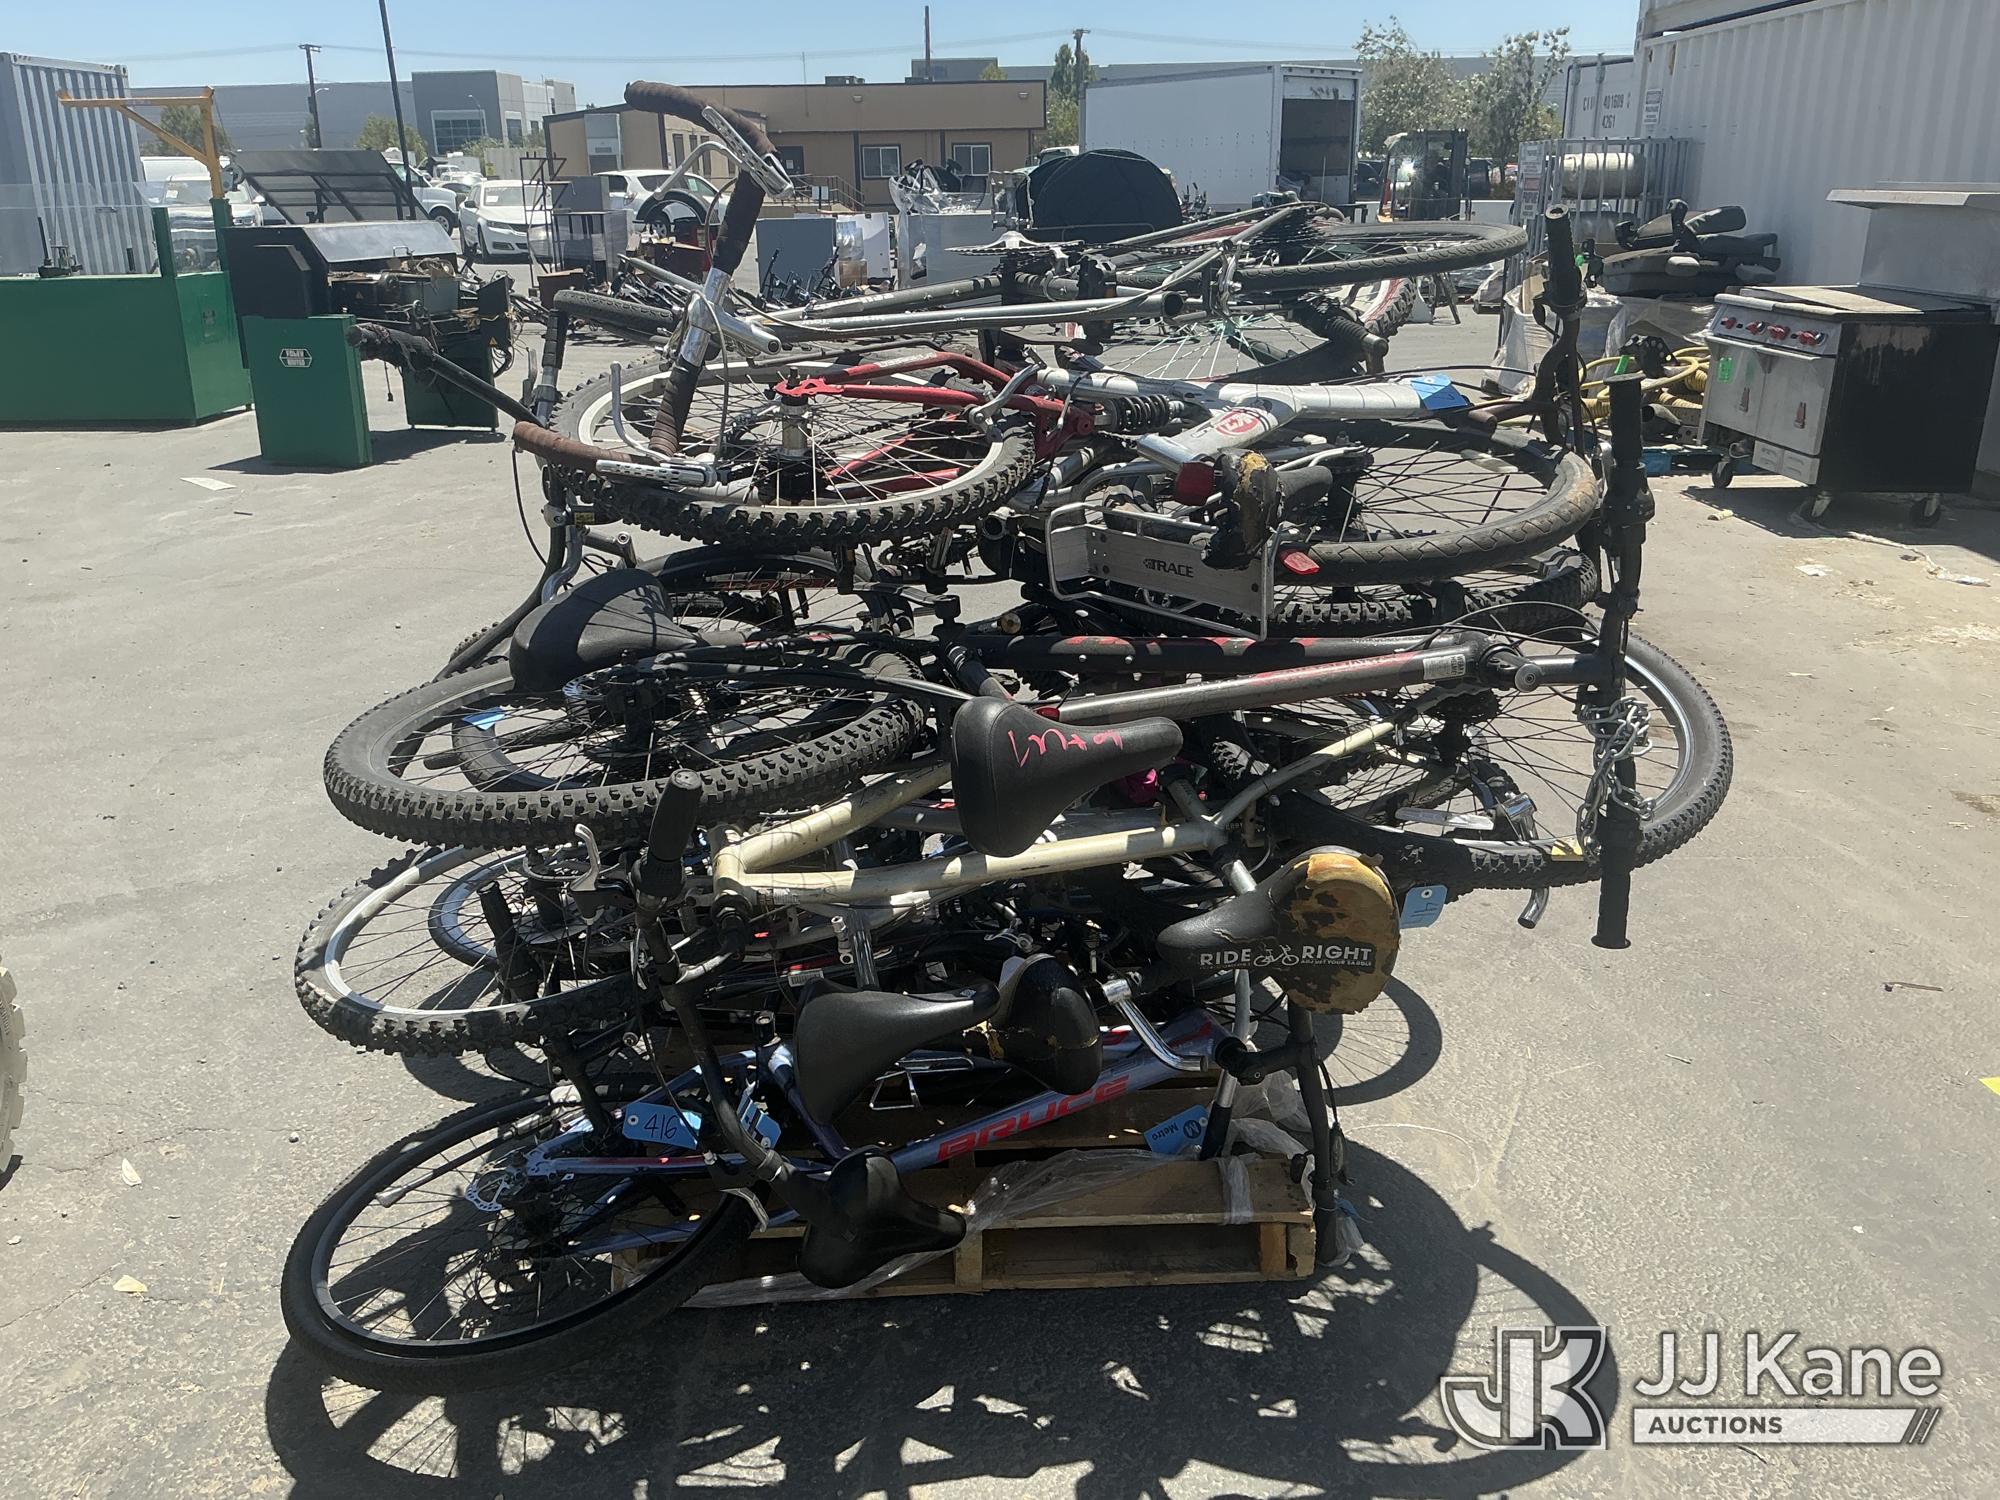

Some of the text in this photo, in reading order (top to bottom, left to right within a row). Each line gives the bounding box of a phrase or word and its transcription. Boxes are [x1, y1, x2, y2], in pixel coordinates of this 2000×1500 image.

[1200, 948, 1251, 966] RIDE
[1301, 944, 1372, 961] RIGHT
[644, 1113, 679, 1139] 416
[1151, 1122, 1179, 1141] Metro
